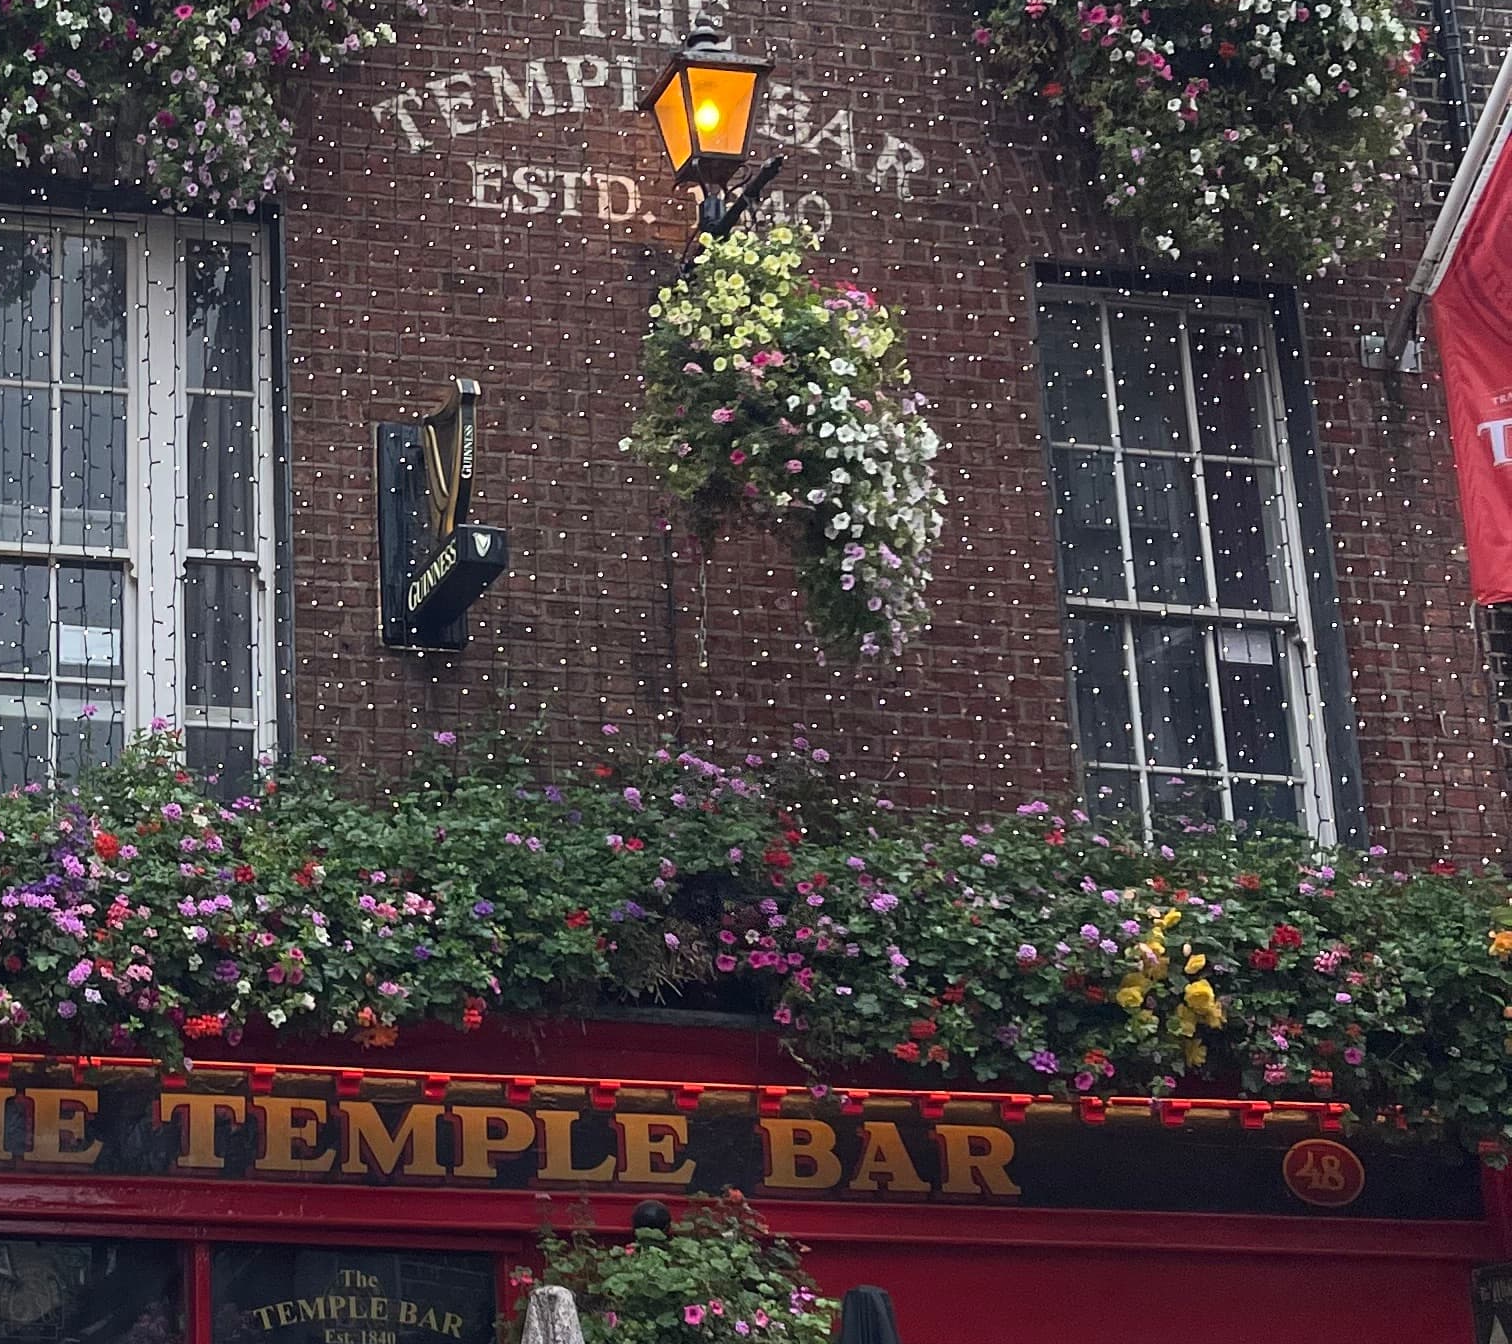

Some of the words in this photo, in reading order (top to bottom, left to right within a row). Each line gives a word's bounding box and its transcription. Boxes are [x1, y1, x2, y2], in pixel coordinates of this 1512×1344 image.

[757, 82, 926, 202] BAR
[461, 424, 473, 479] GUINNESS
[408, 538, 458, 612] GUINNESS
[156, 1092, 696, 1185] TEMPLE
[756, 1117, 1023, 1197] BAR
[1295, 1151, 1345, 1191] 48
[341, 1269, 378, 1289] The
[253, 1295, 388, 1331] TEMPLE
[399, 1300, 464, 1339] BAR
[325, 1329, 355, 1344] Est.
